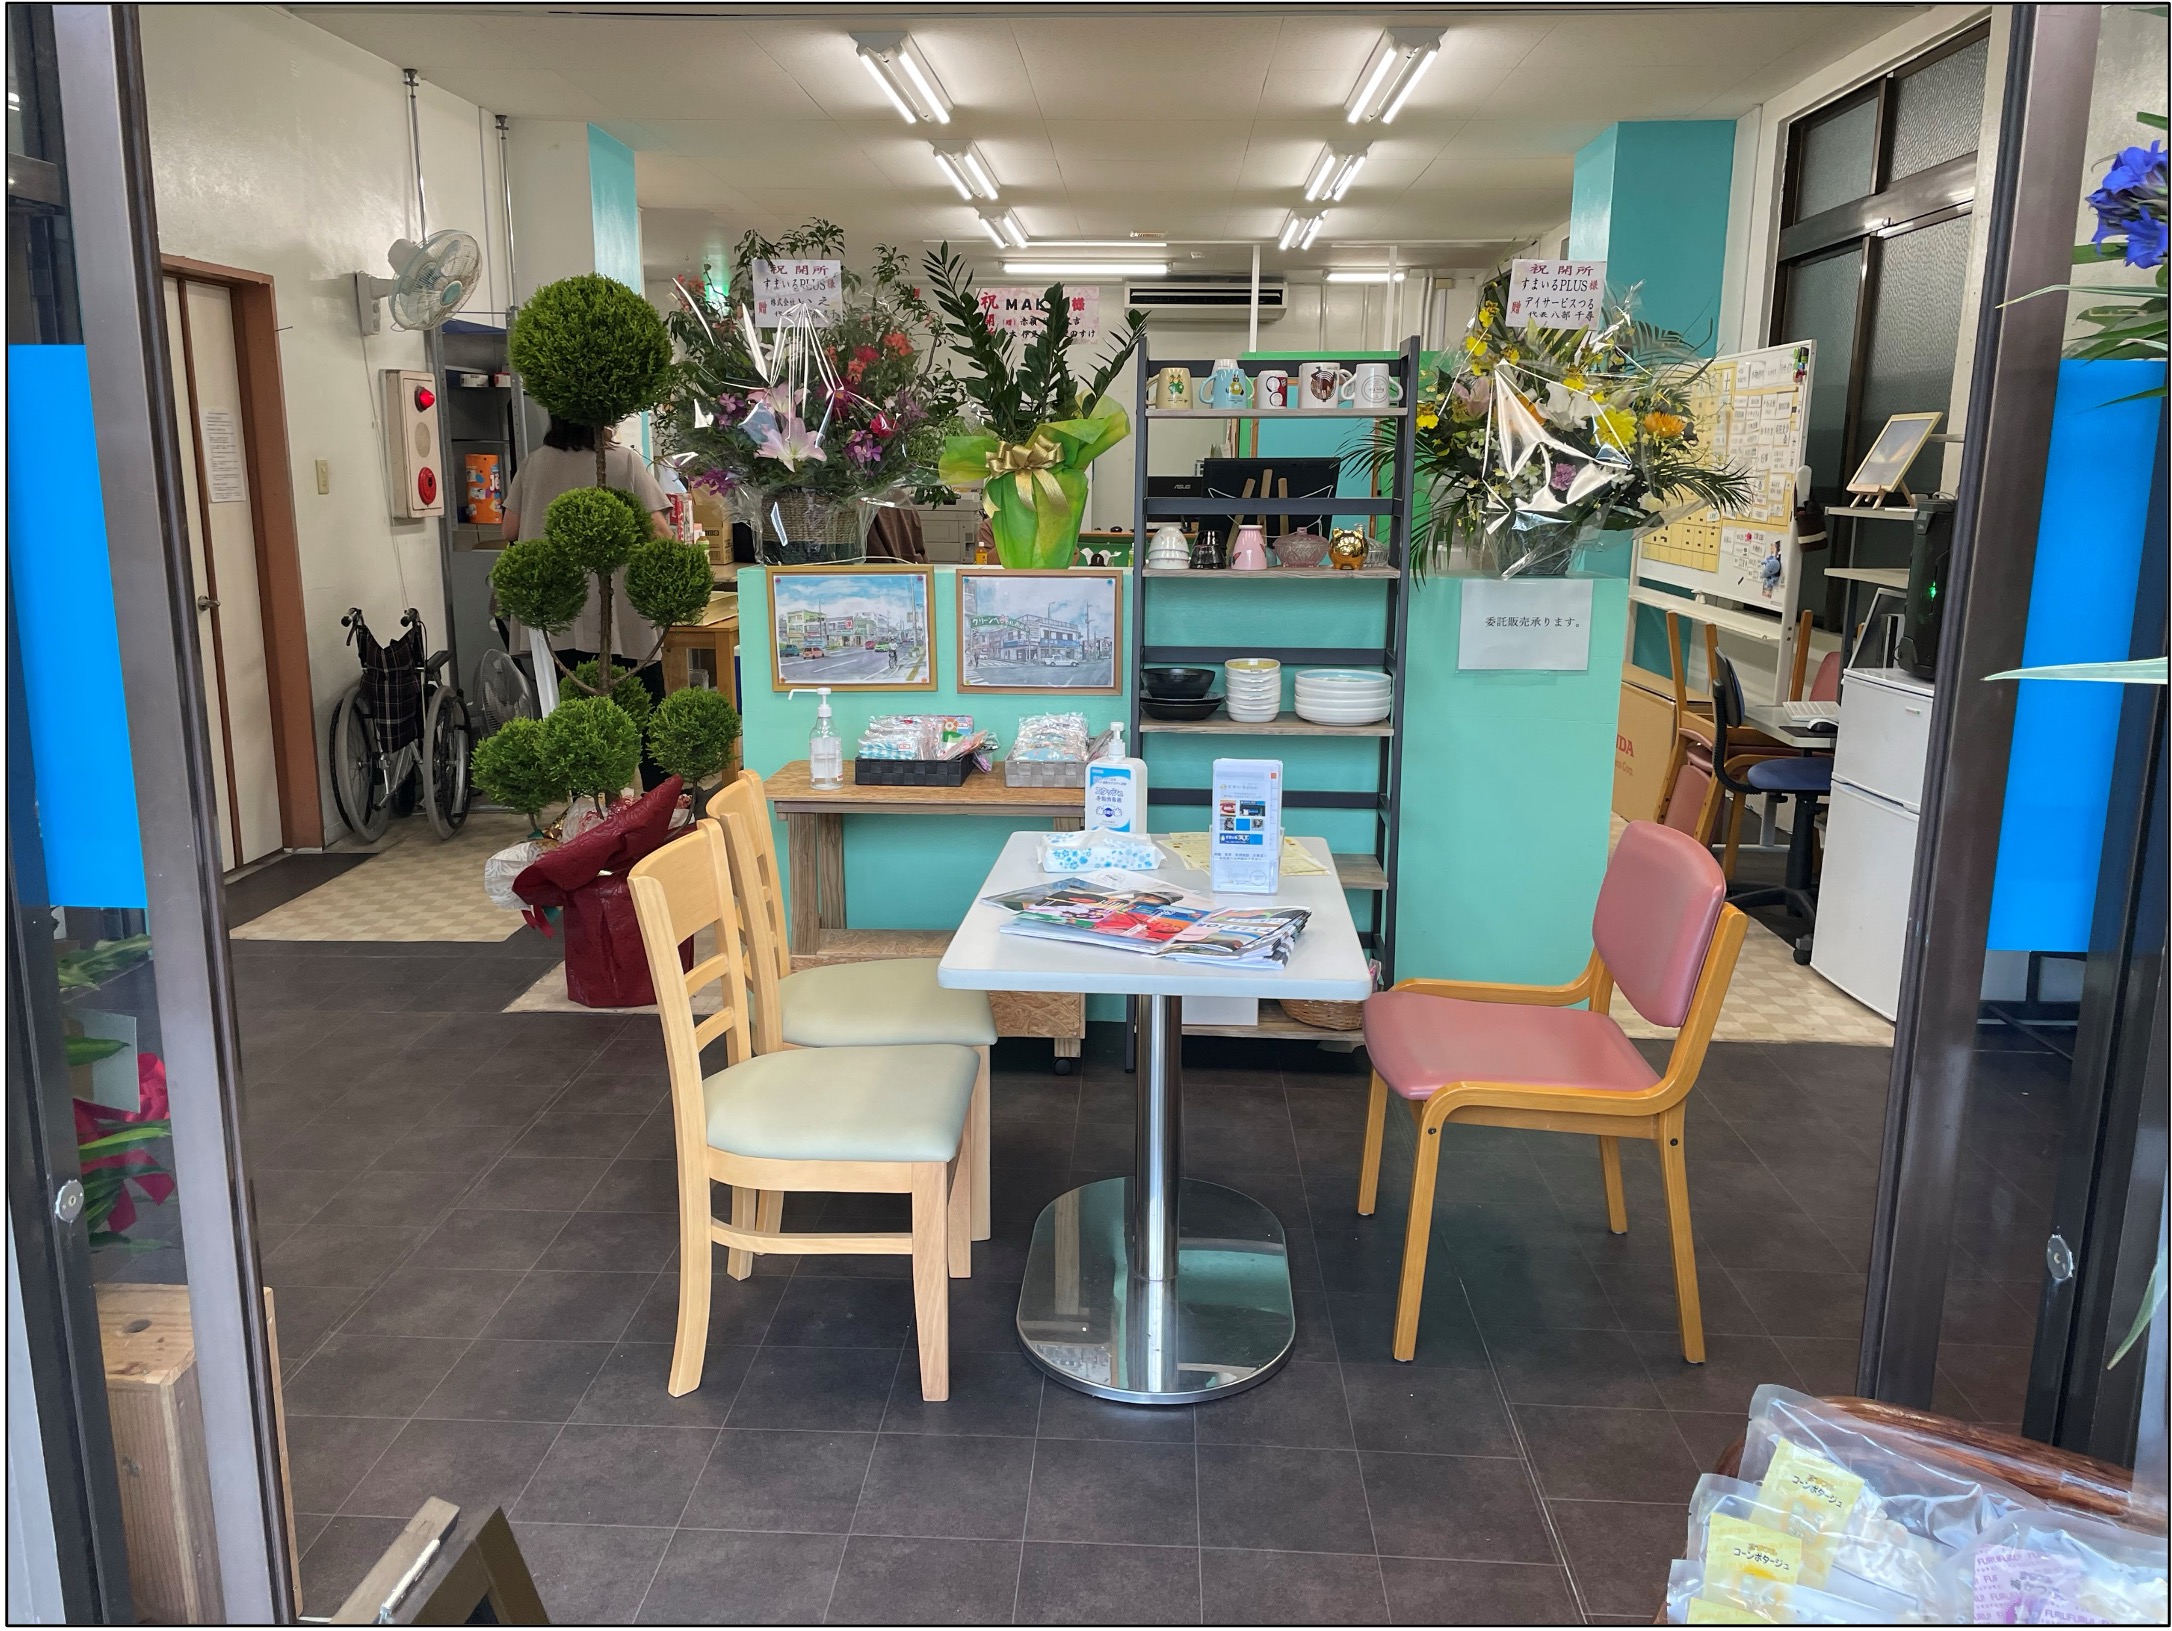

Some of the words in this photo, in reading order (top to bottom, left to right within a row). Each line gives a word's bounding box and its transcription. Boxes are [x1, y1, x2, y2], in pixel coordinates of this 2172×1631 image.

[1484, 616, 1580, 628] 委託販売承ります。
[1792, 1475, 1842, 1508] コーンポタージュ
[1733, 1547, 1789, 1571] コーンポタージュ
